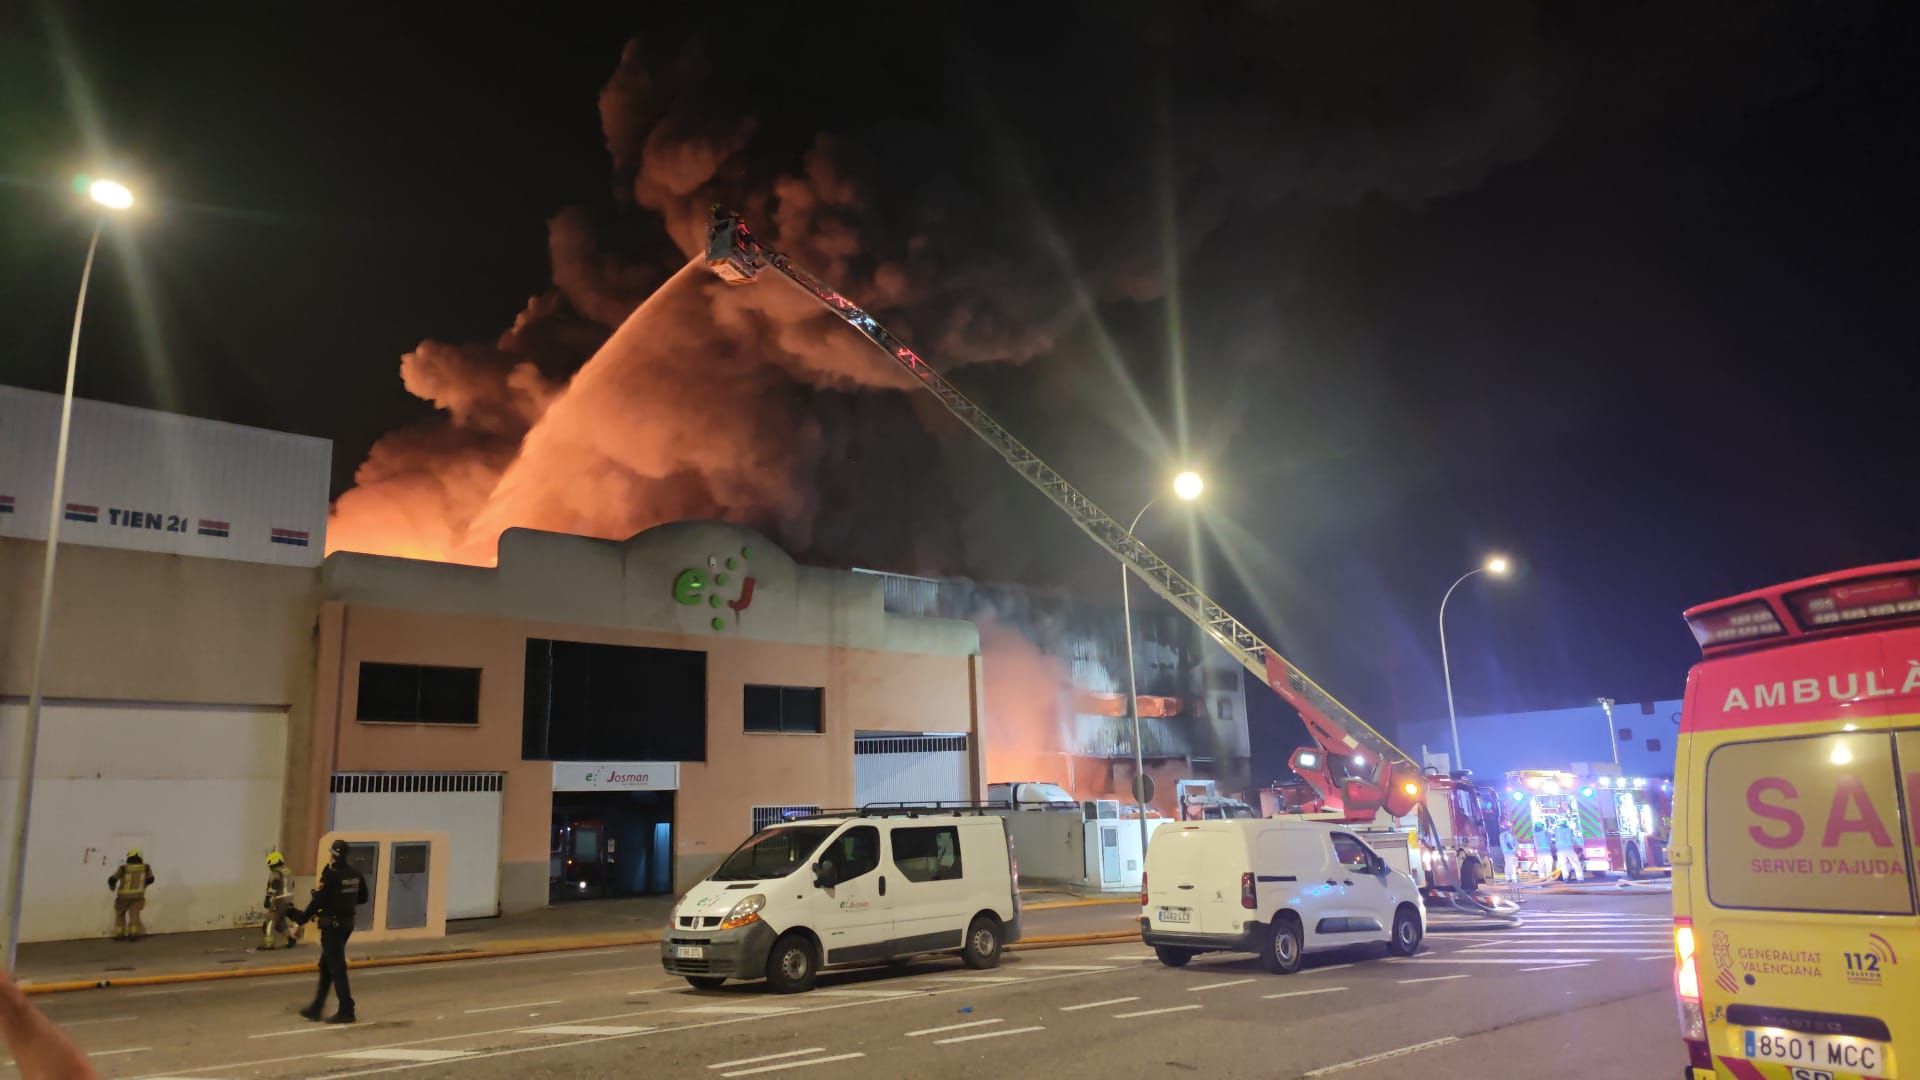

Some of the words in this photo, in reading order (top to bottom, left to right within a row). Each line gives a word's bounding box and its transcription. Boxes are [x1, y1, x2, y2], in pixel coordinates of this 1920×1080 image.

[108, 508, 163, 530] TIEN
[167, 515, 188, 532] 21
[606, 771, 649, 783] Josman
[1746, 772, 1920, 849] SA
[1752, 858, 1813, 874] SERVEI
[1820, 859, 1904, 875] D'AJUDA
[1738, 948, 1821, 964] GENERALITAT
[1844, 952, 1880, 971] 112
[1740, 961, 1822, 977] VALENCIANA
[1760, 1035, 1815, 1062] 8501
[1828, 1042, 1875, 1069] MCC
